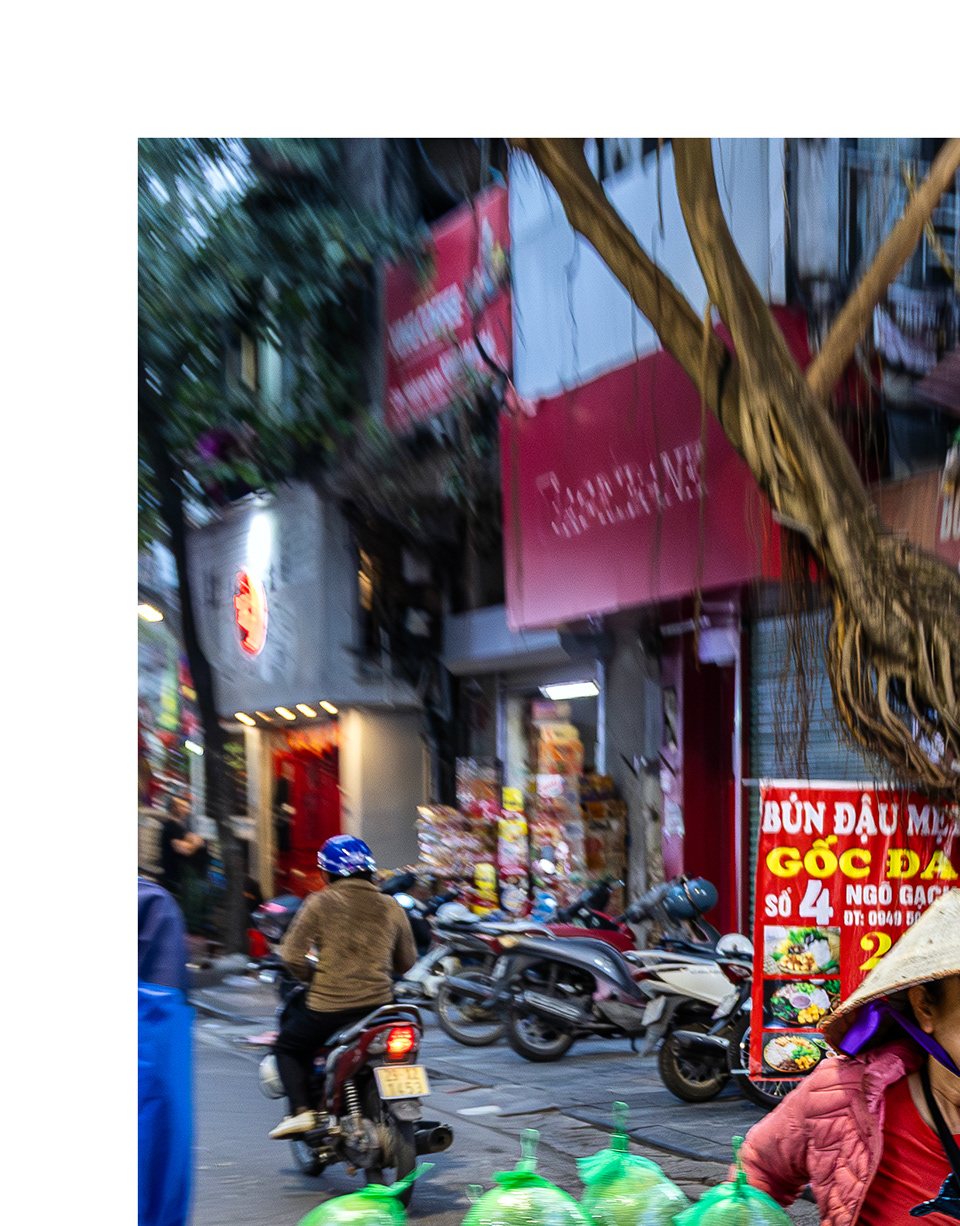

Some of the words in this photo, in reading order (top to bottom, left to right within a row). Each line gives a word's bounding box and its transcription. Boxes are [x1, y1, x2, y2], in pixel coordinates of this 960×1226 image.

[762, 792, 825, 835] BÚN
[833, 793, 899, 844] ĐẬU
[766, 834, 872, 880] GỐC
[886, 848, 959, 880] ĐA
[799, 879, 834, 926] 4
[900, 884, 956, 910] GẠC
